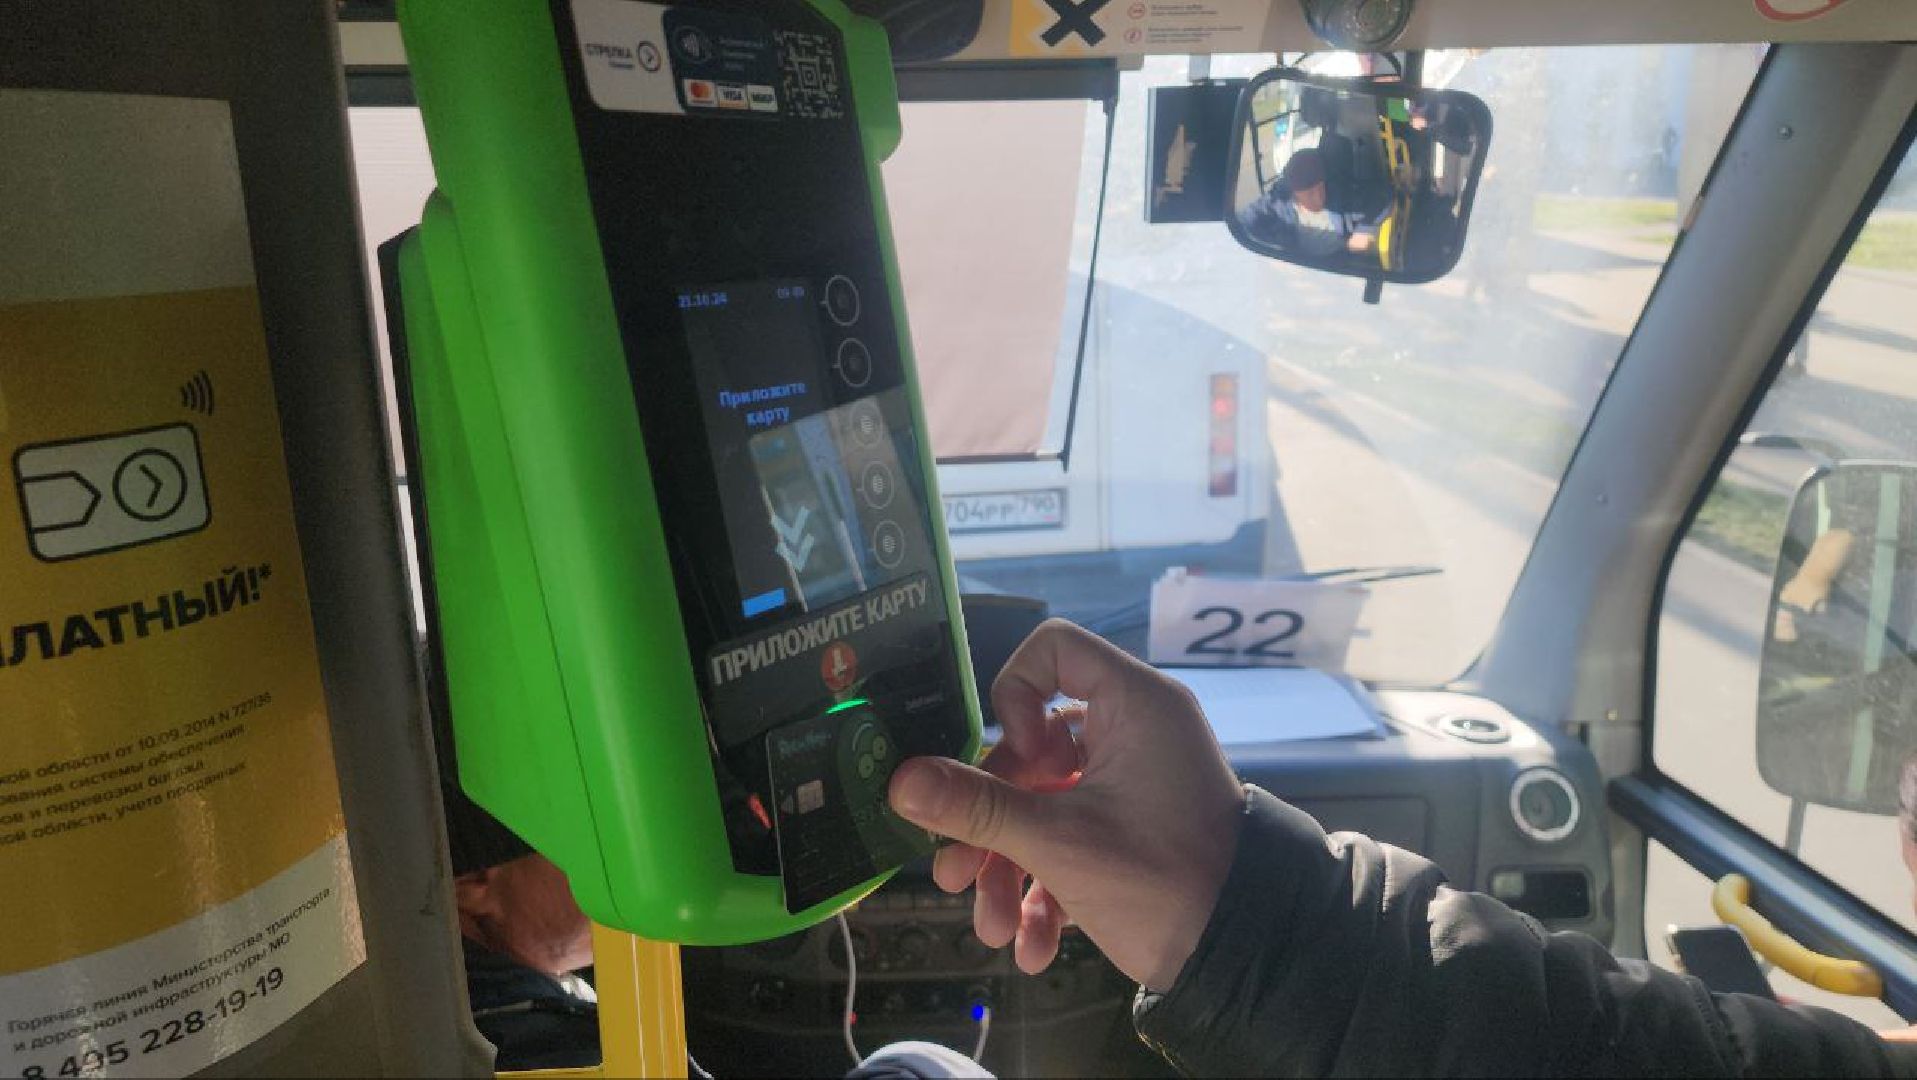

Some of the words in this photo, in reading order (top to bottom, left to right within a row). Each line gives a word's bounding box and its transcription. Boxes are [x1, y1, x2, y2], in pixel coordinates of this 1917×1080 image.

[718, 382, 807, 410] Приложите
[746, 406, 790, 427] карту
[0, 562, 272, 668] ЛАТНЫЙ!
[711, 605, 865, 686] ПРИЛОЖИТЕ
[866, 579, 927, 625] КАРТУ
[1184, 605, 1306, 659] 22
[36, 750, 110, 777] области
[115, 745, 133, 759] от
[138, 715, 217, 751] 10.09.2014
[70, 762, 143, 790] системы
[148, 723, 246, 767] обеспечения
[30, 809, 41, 820] и
[46, 781, 143, 815] перевозки
[7, 1004, 87, 1034] Горячая
[92, 984, 148, 1011] линия
[152, 930, 264, 990] Министерства
[264, 887, 332, 938] транспорта
[13, 1041, 25, 1053] и
[31, 1009, 130, 1052] дорожной
[131, 946, 267, 1020] инфраструктуры
[267, 931, 291, 953] МО
[58, 1040, 130, 1078] 495
[139, 965, 285, 1054] 228-19-19
